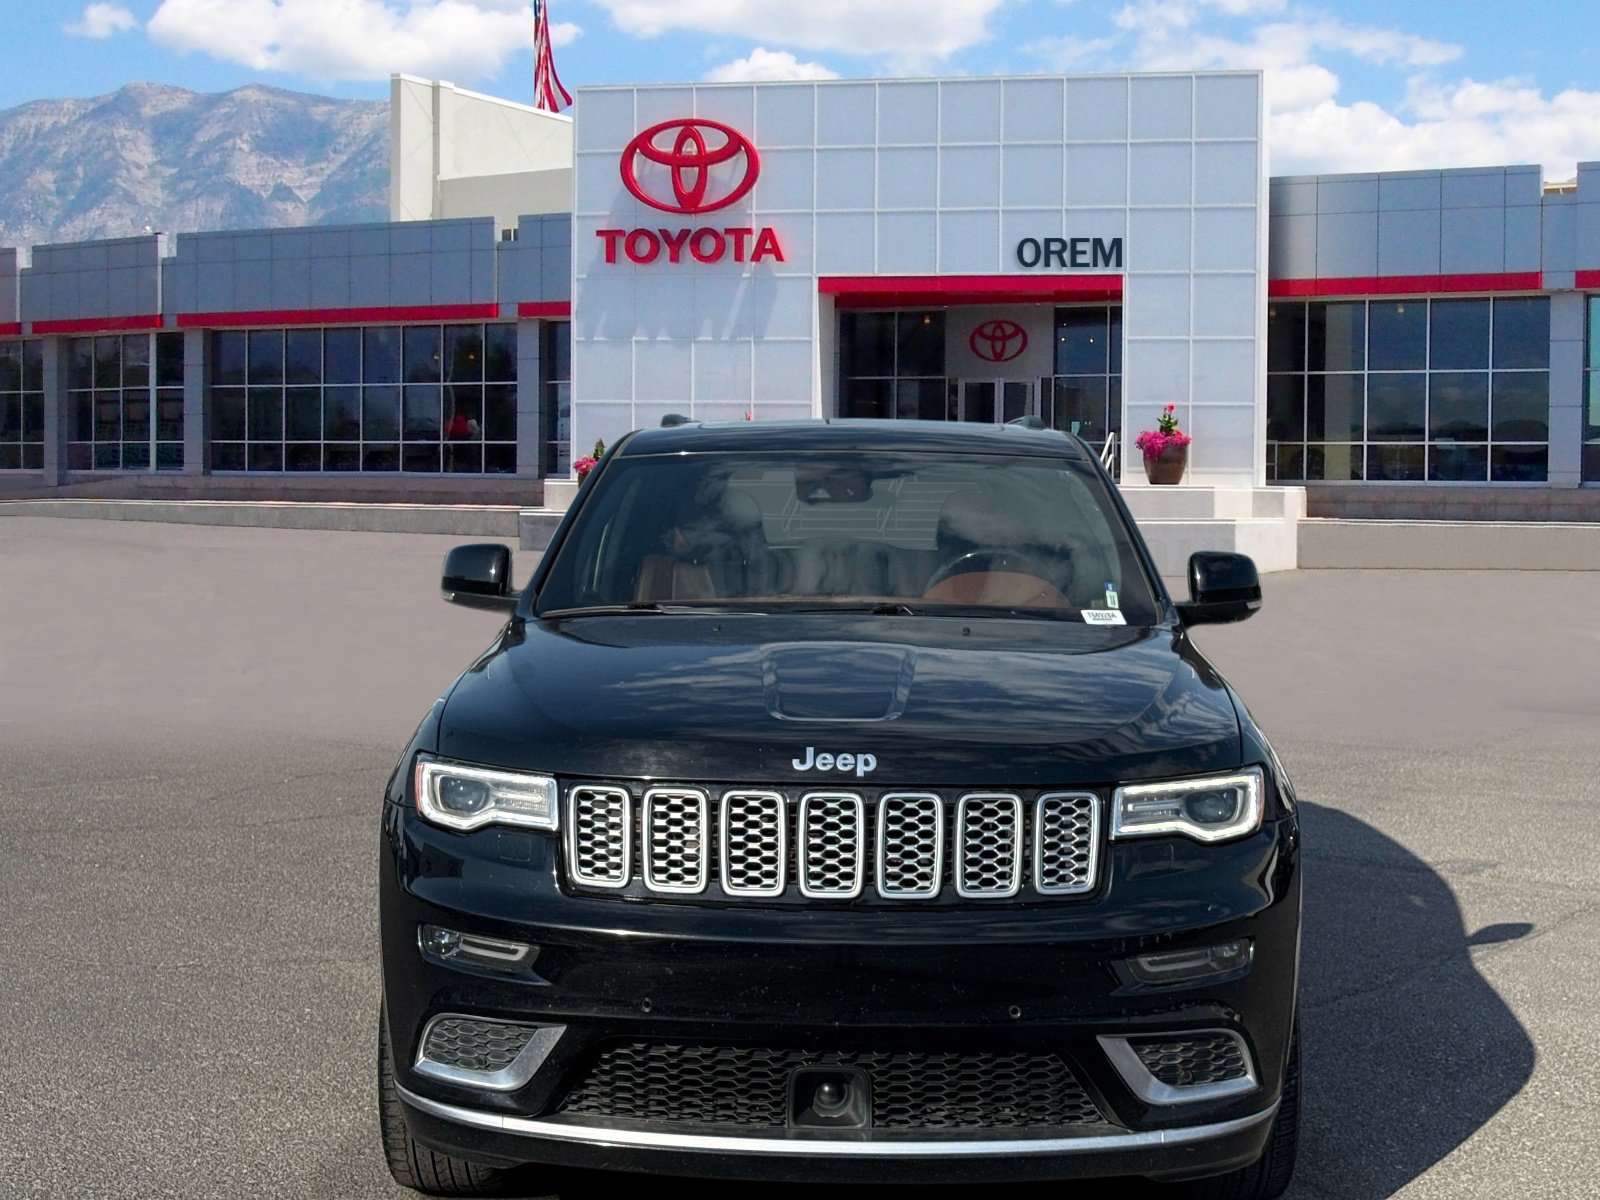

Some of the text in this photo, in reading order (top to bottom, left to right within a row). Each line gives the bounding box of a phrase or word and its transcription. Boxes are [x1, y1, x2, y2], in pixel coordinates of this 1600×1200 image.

[596, 227, 785, 265] TOYOTA
[1016, 237, 1123, 268] OREM
[791, 746, 878, 777] Jeep
